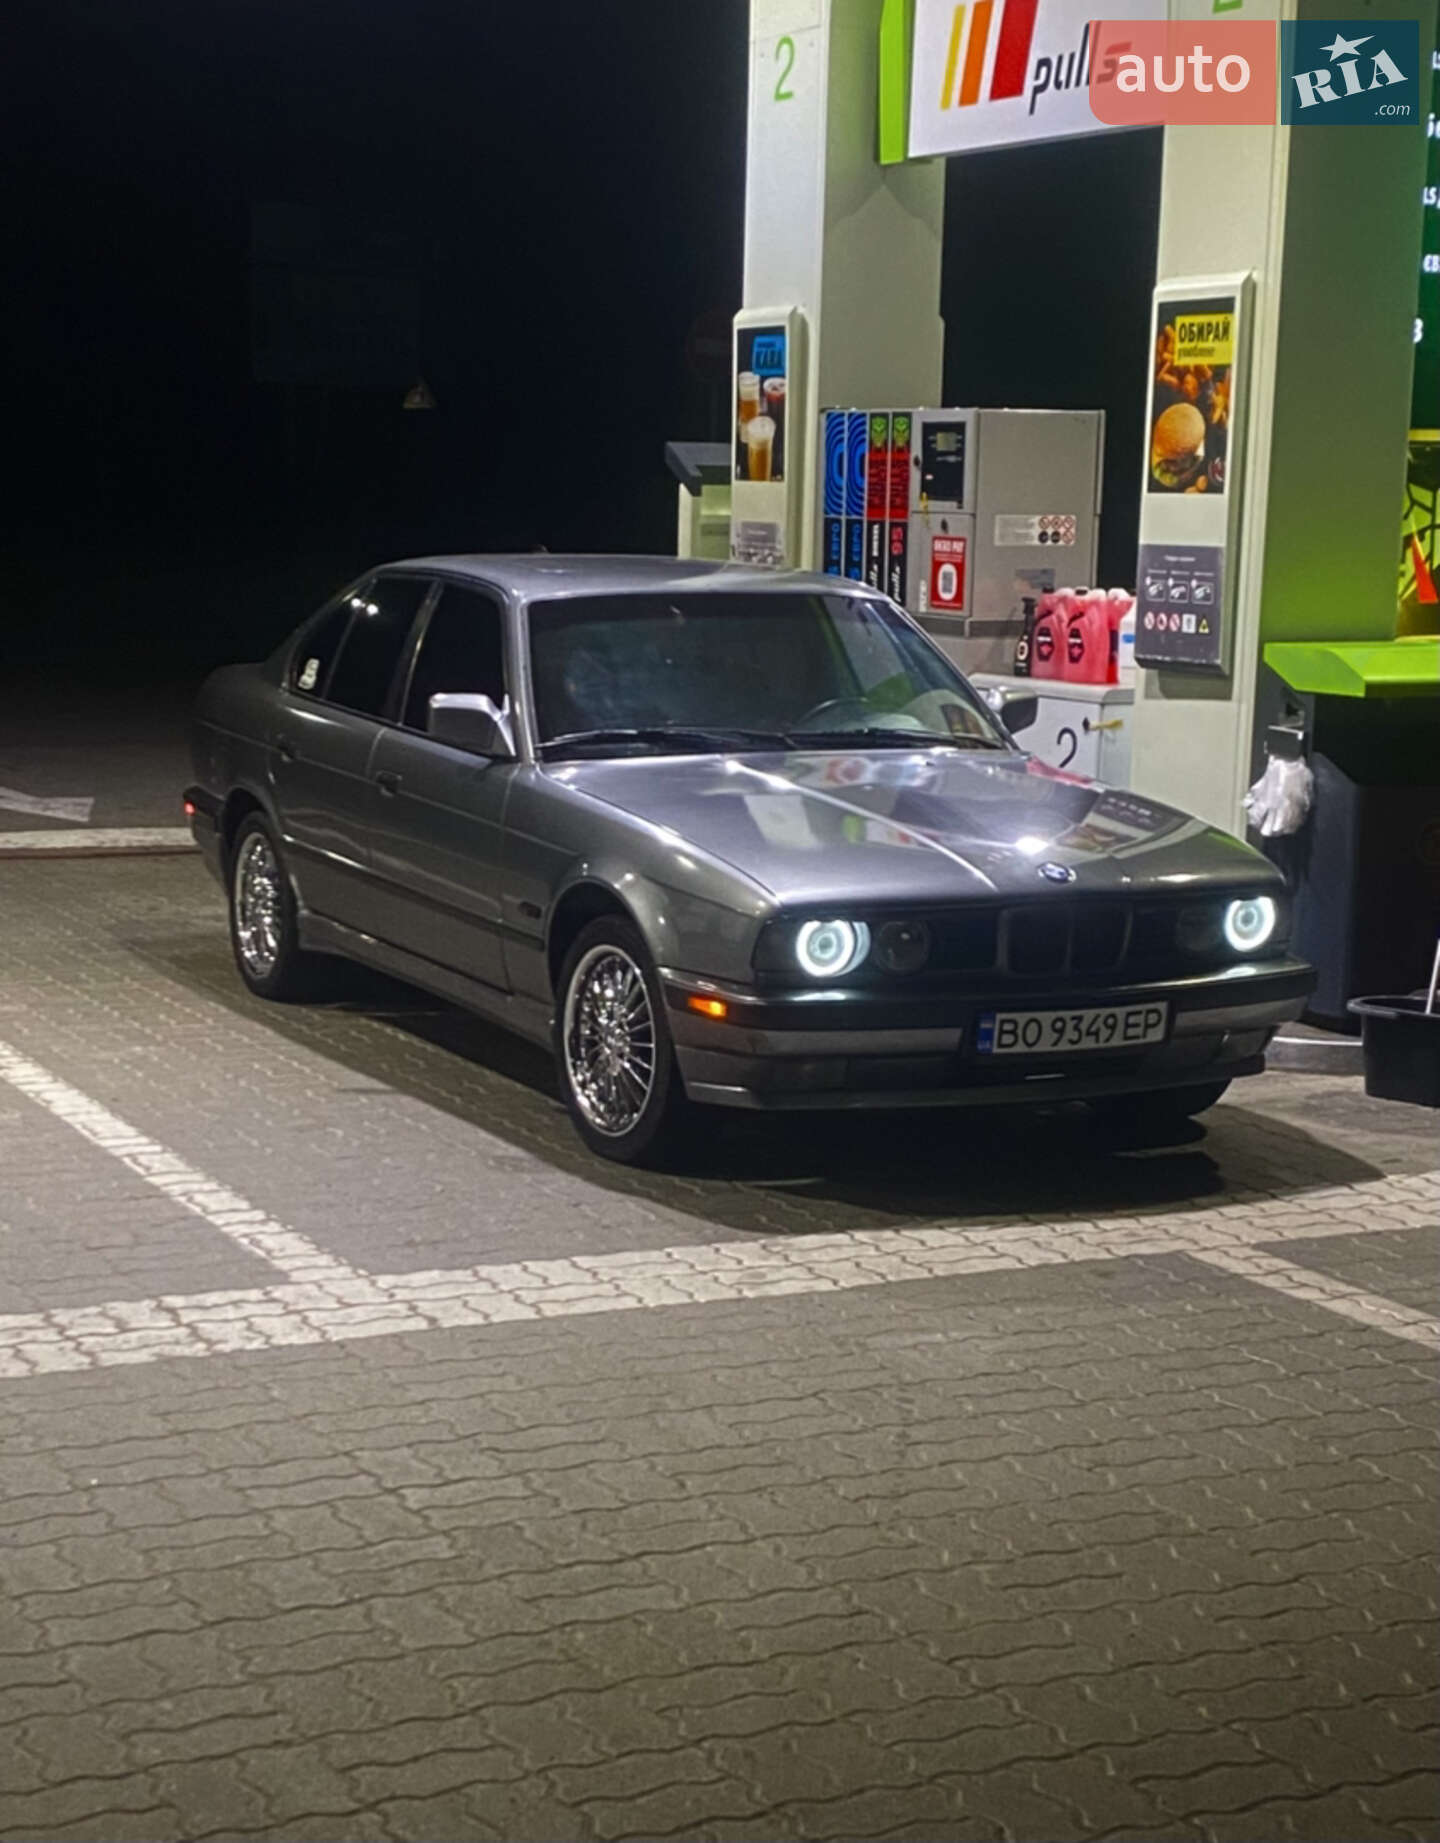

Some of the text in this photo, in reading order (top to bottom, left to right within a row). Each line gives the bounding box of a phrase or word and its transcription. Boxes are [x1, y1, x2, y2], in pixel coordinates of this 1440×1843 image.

[773, 36, 795, 102] 2
[1178, 316, 1231, 343] ОБИРАЙ
[1056, 727, 1077, 768] 2
[996, 1008, 1163, 1049] BO 9349 EP
